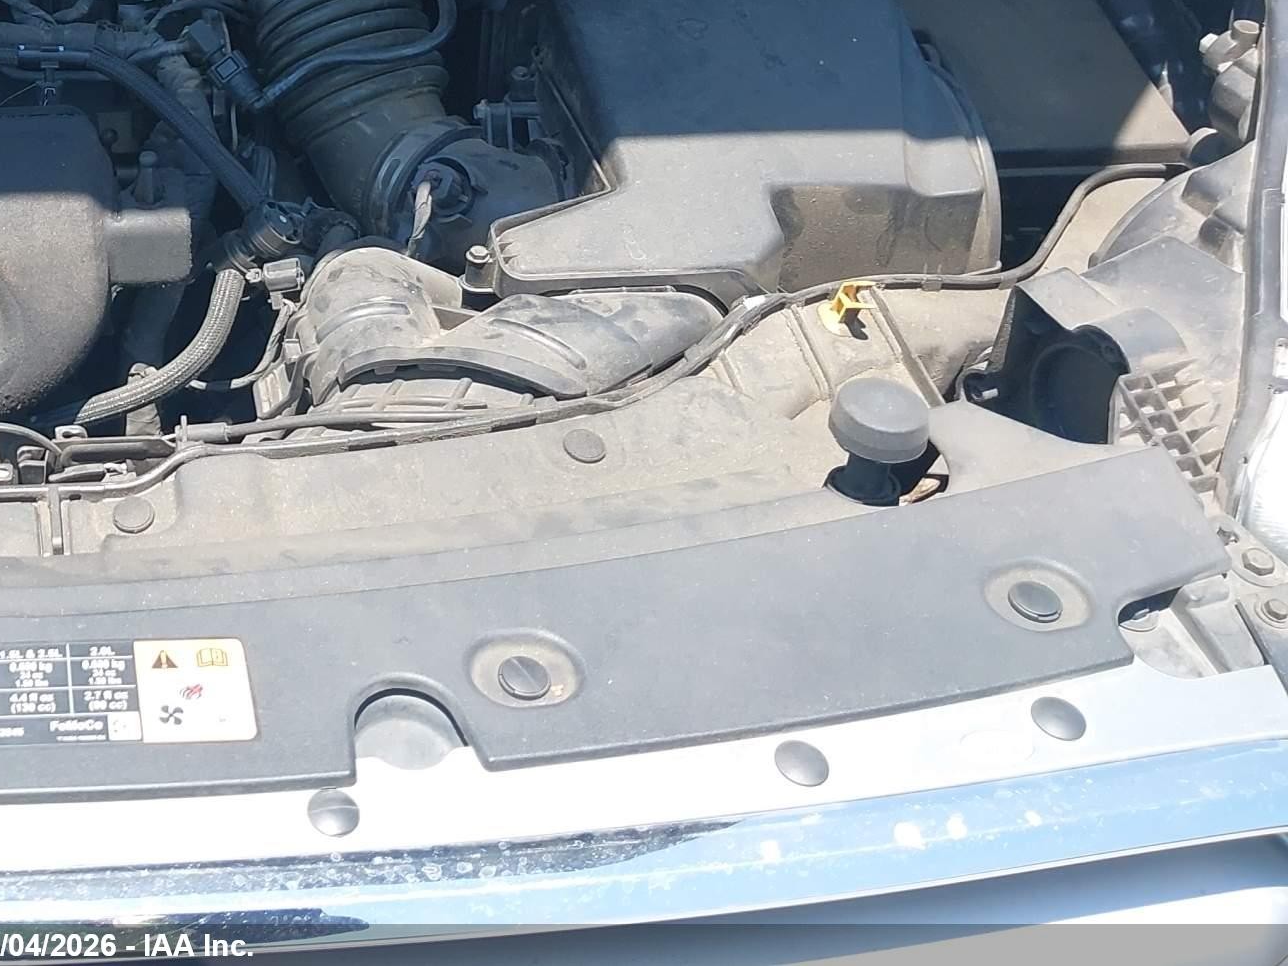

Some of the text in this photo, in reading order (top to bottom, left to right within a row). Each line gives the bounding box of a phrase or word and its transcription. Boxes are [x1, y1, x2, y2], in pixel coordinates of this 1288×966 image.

[25, 649, 36, 659] &
[38, 661, 53, 673] kg
[111, 658, 126, 671] kg
[39, 693, 54, 702] oz
[84, 691, 101, 701] 2.7
[114, 691, 129, 700] oz
[37, 702, 57, 713] cc)
[108, 700, 128, 711] cc)
